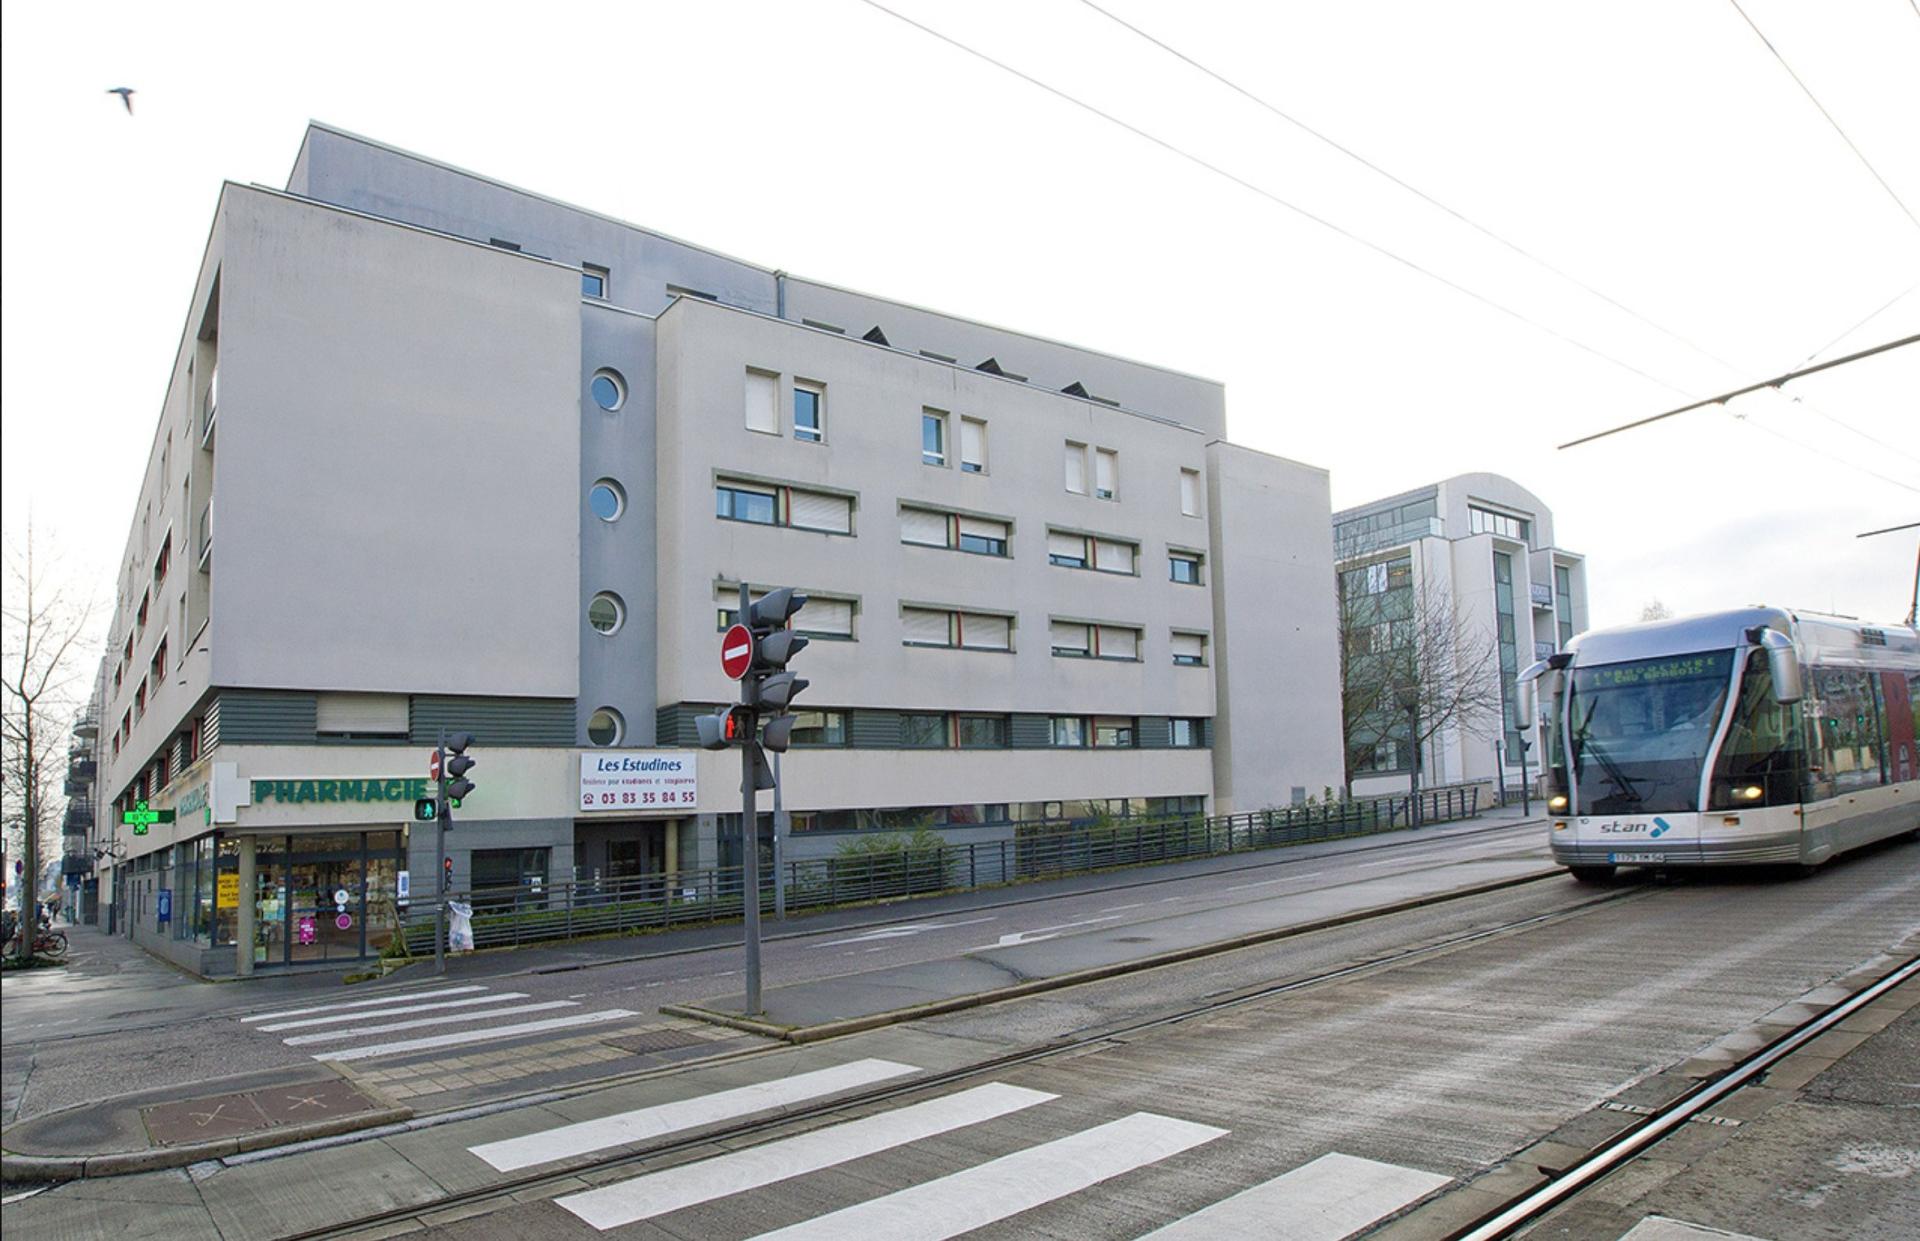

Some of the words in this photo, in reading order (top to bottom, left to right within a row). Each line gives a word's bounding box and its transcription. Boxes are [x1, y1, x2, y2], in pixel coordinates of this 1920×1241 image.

[598, 758, 620, 771] Les
[622, 757, 682, 771] Estudines
[255, 779, 427, 803] PHARMACIE
[601, 792, 616, 804] 03
[622, 792, 636, 804] 83
[642, 792, 656, 804] 35
[662, 791, 676, 803] 84
[682, 791, 695, 803] 55
[1600, 821, 1648, 833] stan
